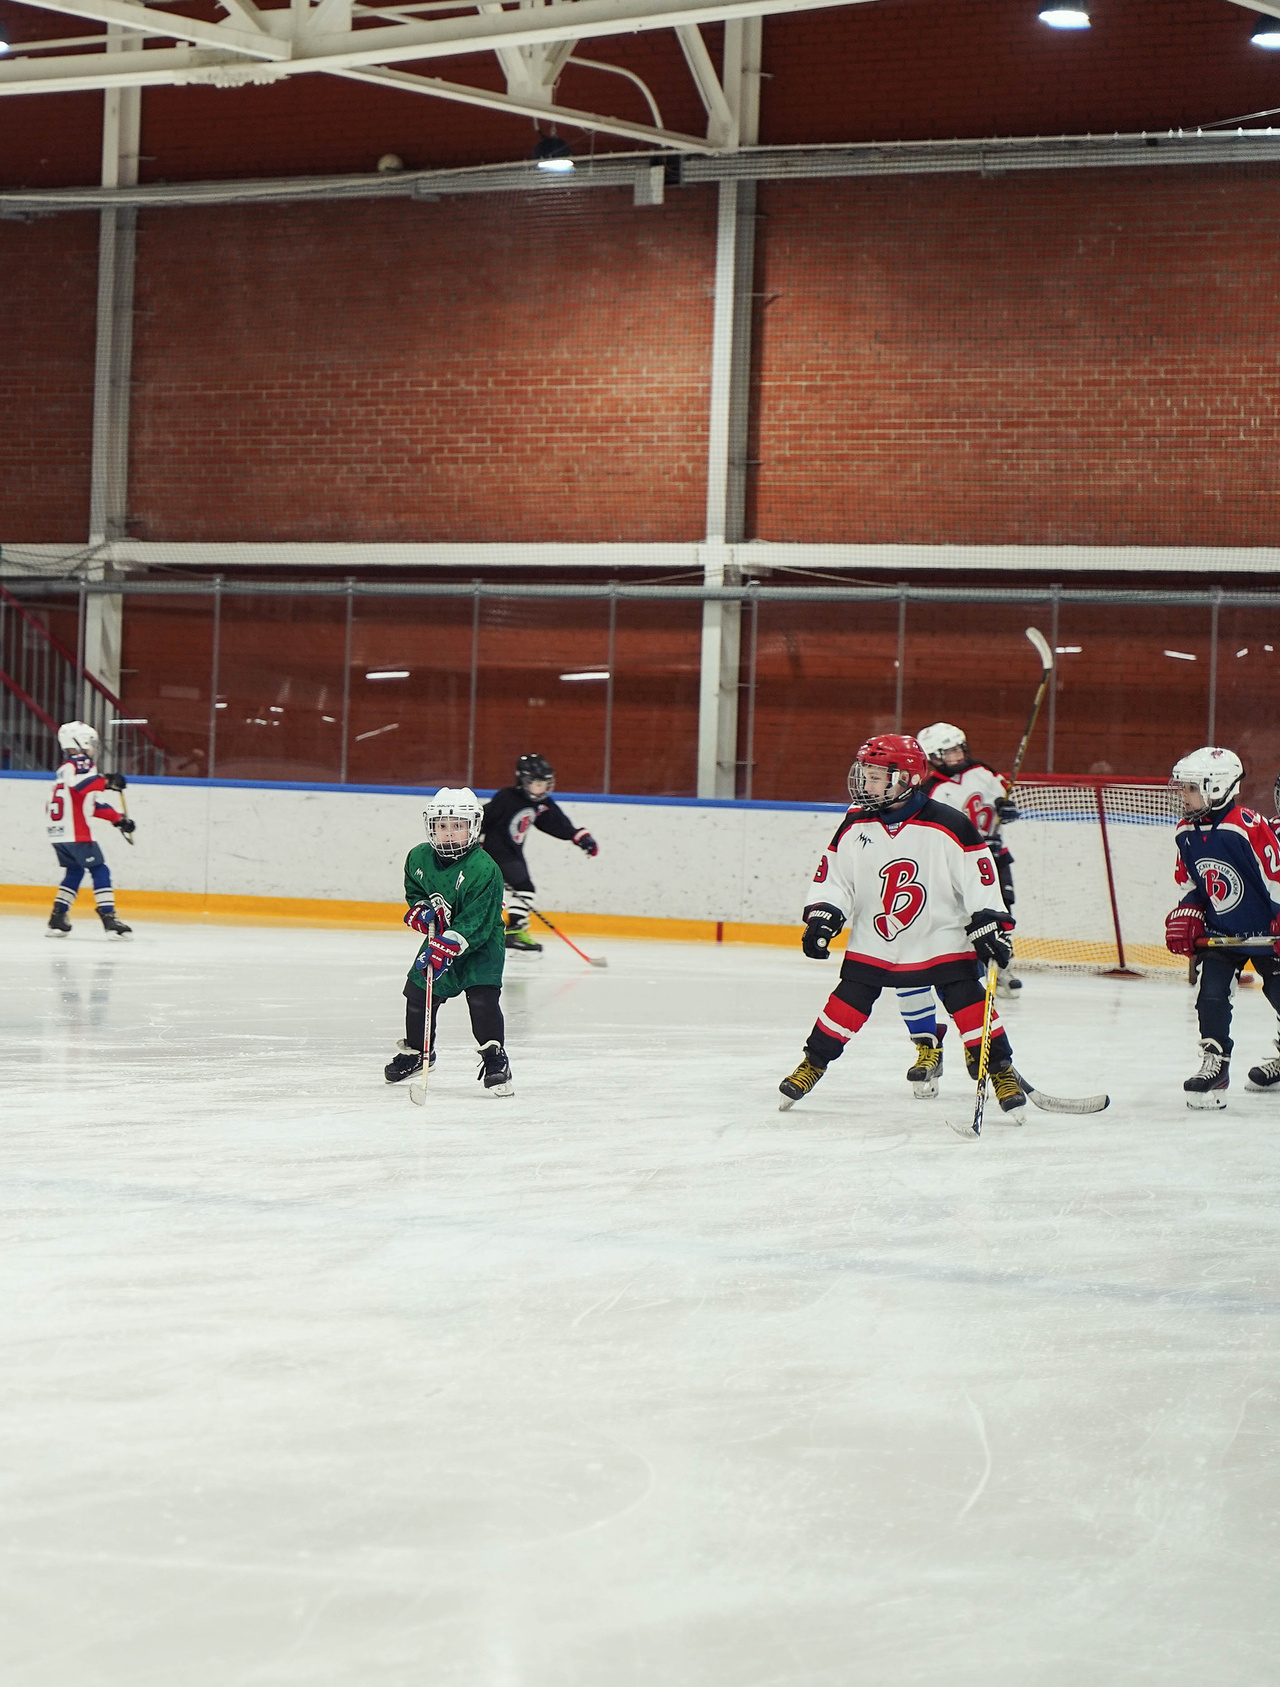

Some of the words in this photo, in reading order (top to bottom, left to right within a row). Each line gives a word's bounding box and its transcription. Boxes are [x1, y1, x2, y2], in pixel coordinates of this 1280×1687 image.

[47, 783, 65, 822] 5
[976, 856, 996, 887] 9
[872, 857, 927, 942] B
